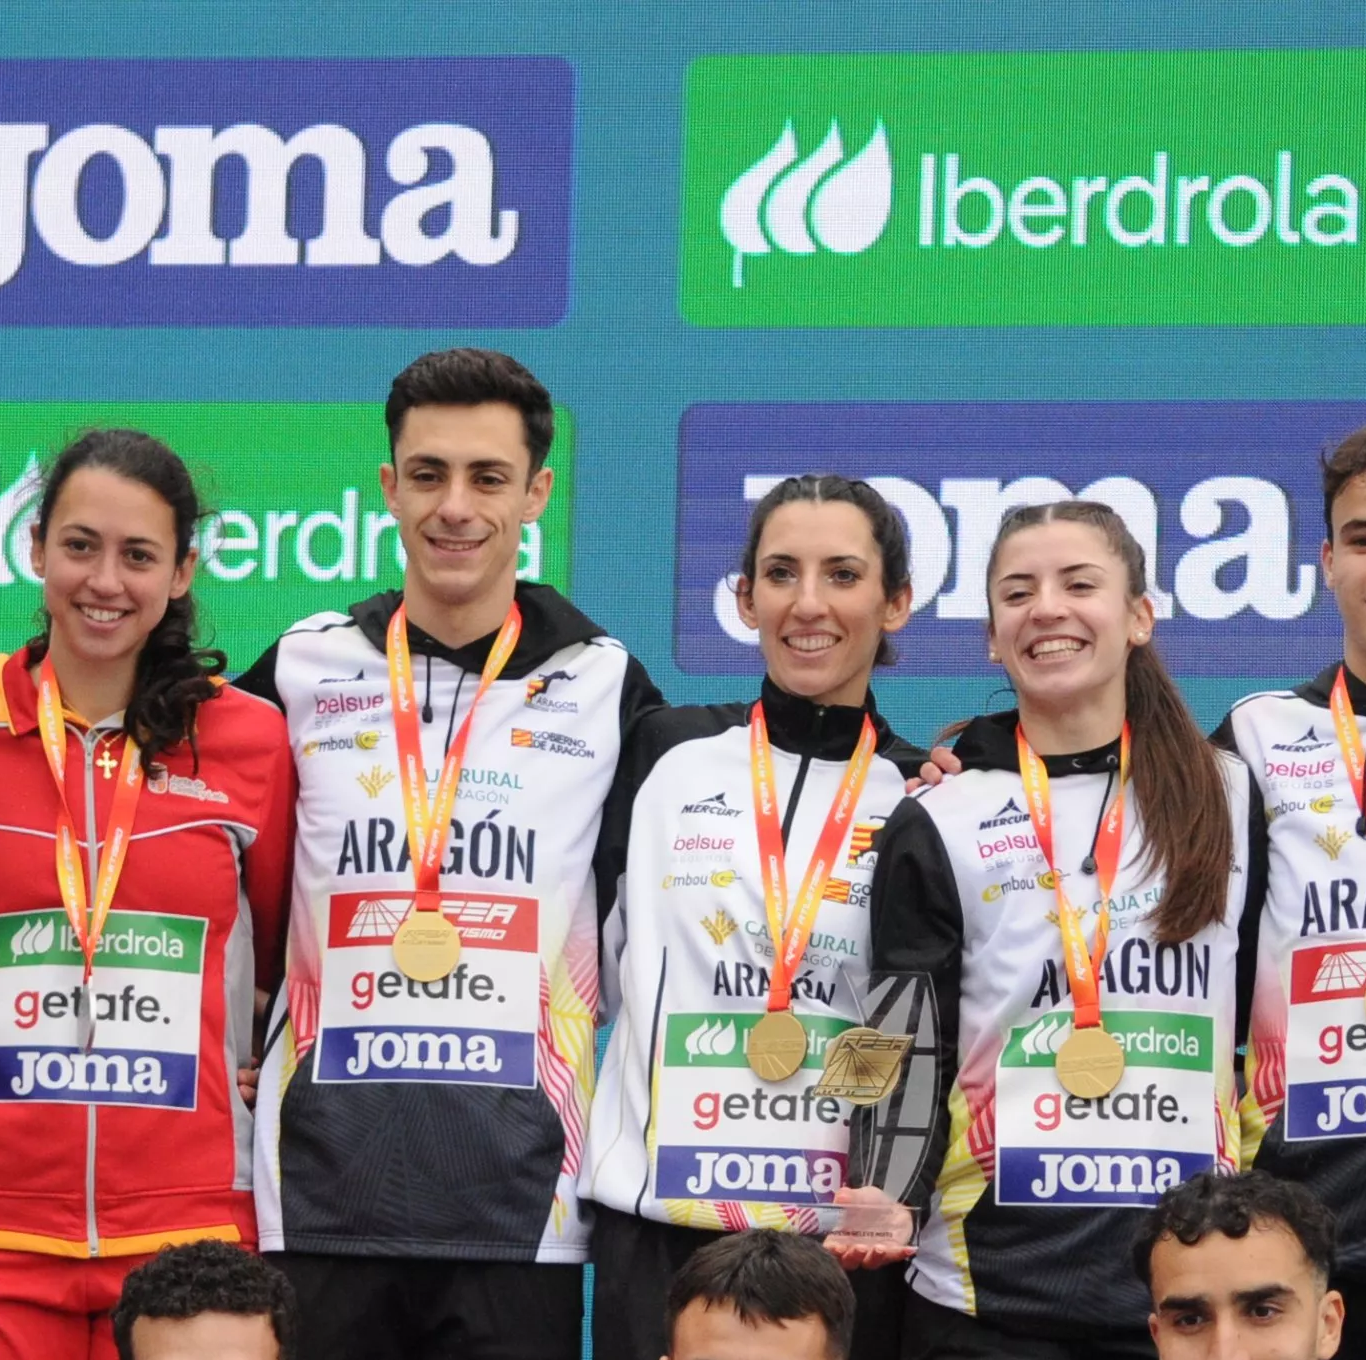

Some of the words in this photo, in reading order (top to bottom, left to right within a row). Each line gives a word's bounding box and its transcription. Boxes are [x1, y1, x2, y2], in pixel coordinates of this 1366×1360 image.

[918, 150, 1359, 248] Iberdrola
[315, 692, 384, 715] belsue
[531, 730, 587, 748] GOBIERNO
[531, 738, 546, 751] DE
[681, 804, 744, 818] MERCURY
[979, 813, 1031, 830] MERCUR
[673, 834, 734, 851] belsue
[977, 832, 1040, 859] belsu
[662, 872, 708, 889] embou
[981, 874, 1035, 903] embou
[809, 931, 858, 956] URAL
[346, 1032, 503, 1076] Joma
[11, 1051, 167, 1095] Joma
[687, 1152, 847, 1194] Joma
[1031, 1154, 1185, 1198] Joma
